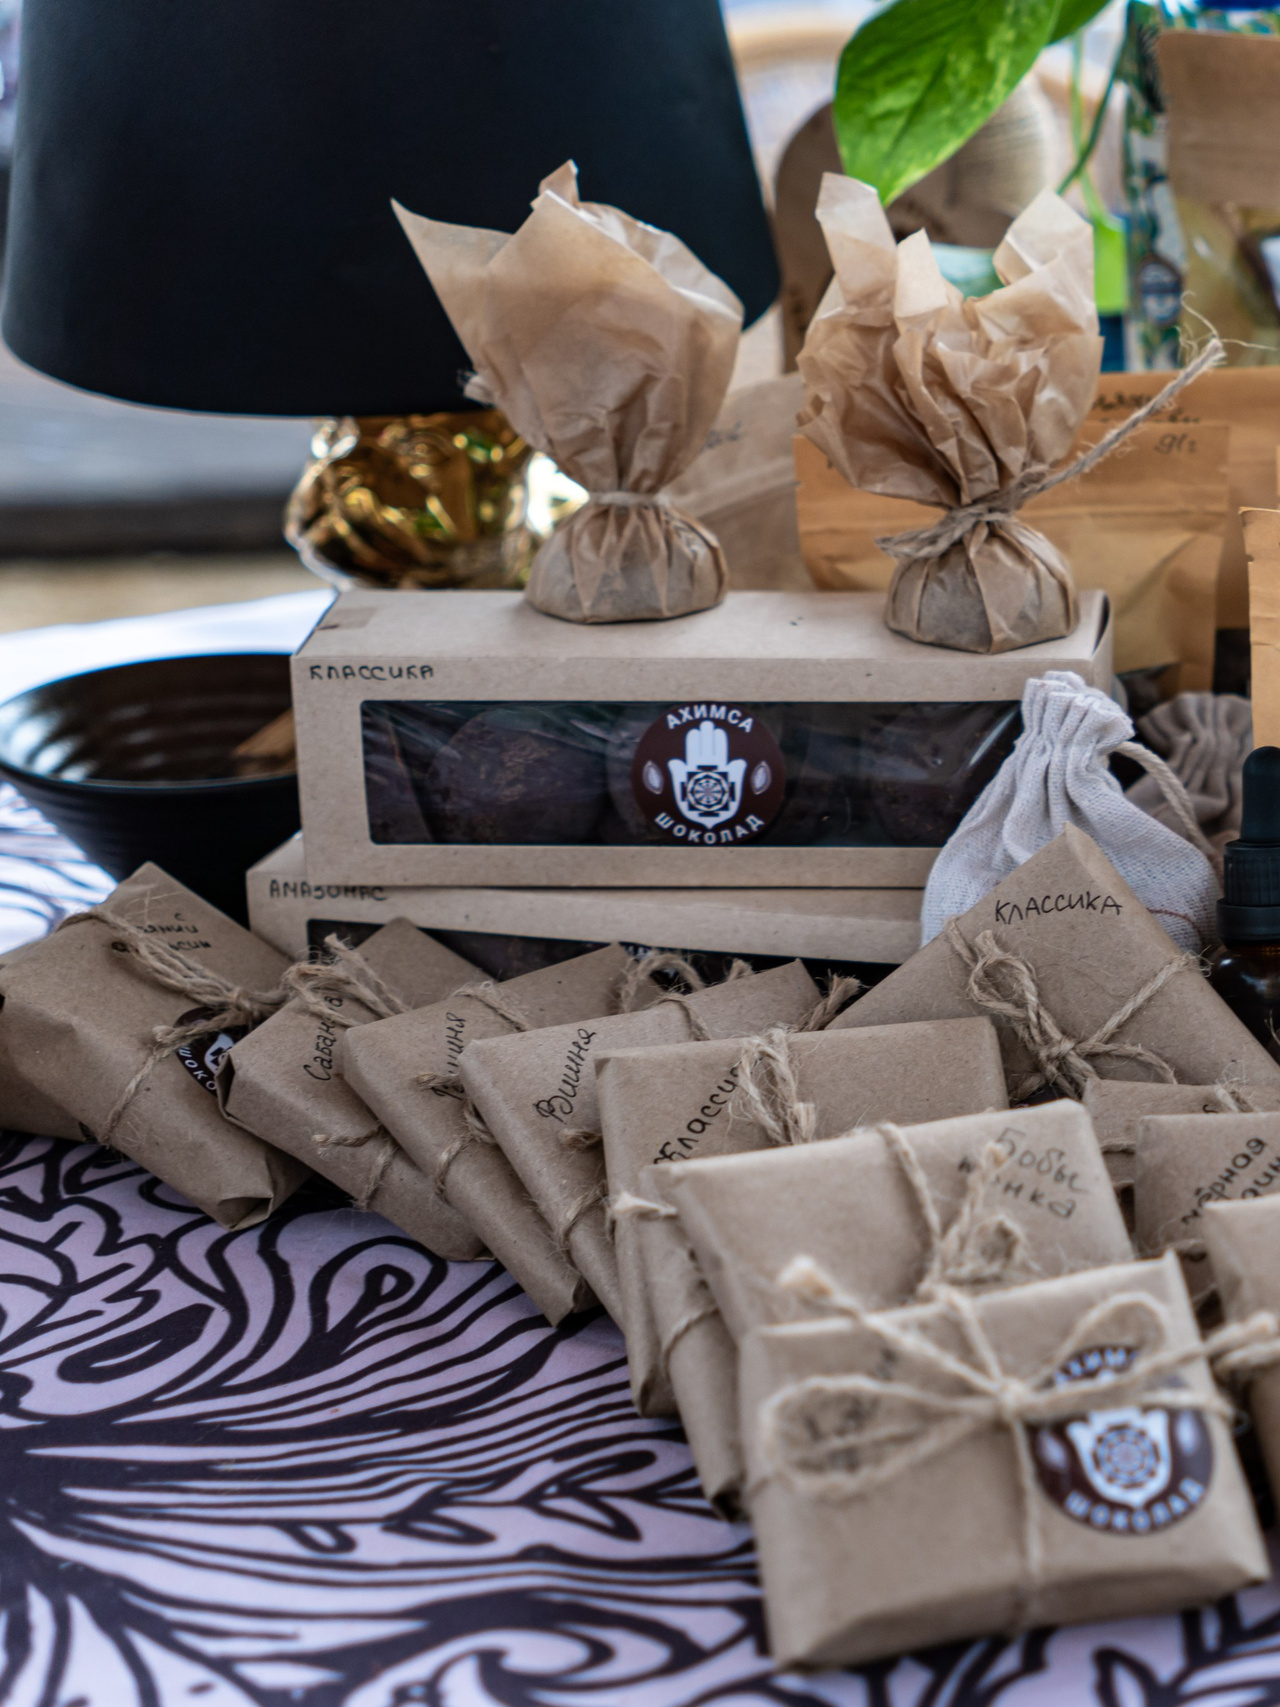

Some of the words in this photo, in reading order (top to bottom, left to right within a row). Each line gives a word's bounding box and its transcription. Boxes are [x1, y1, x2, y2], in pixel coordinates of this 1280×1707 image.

[666, 703, 754, 733] АХИМСА
[654, 811, 766, 845] ШОКОЛАД
[995, 890, 1124, 925] КЛАССИКА
[178, 1046, 217, 1091] ШОКО
[1064, 1476, 1205, 1531] ШОКОЛАД
